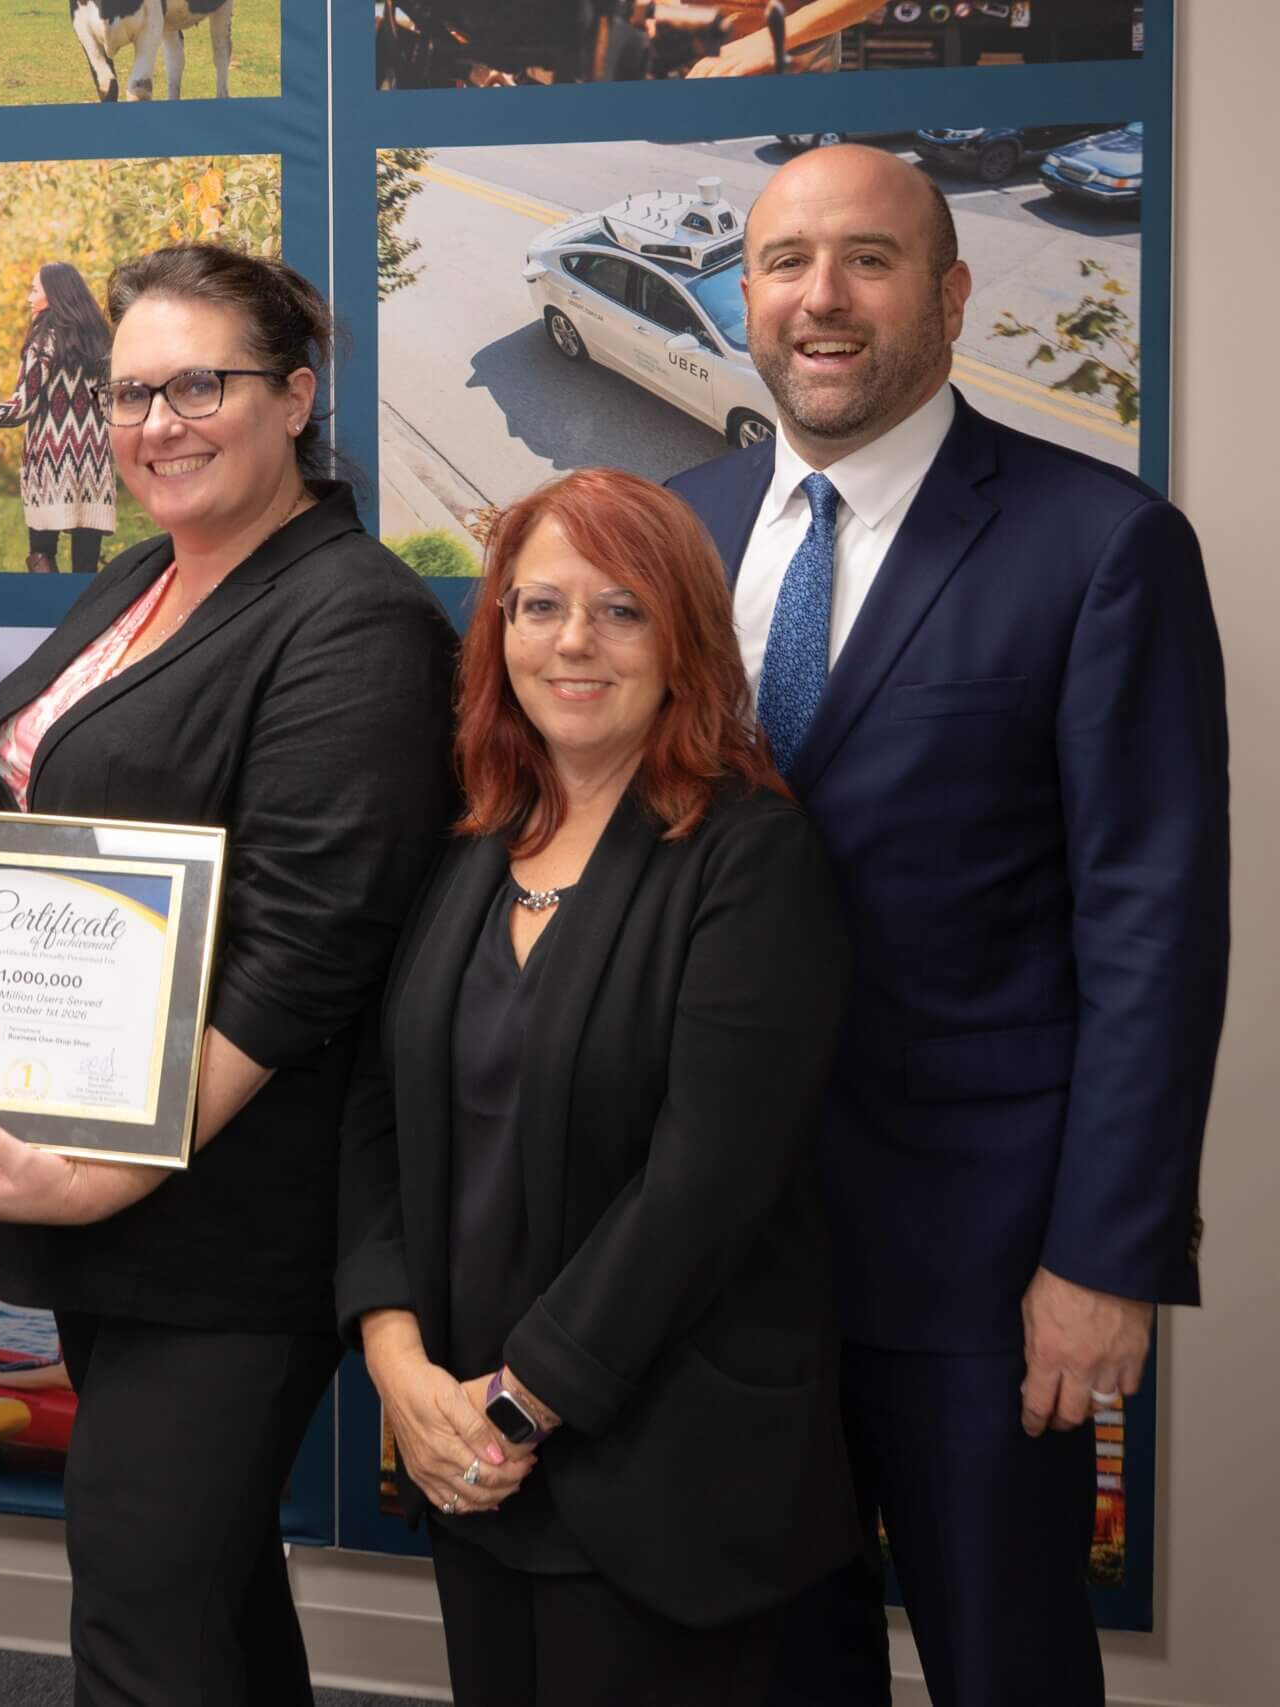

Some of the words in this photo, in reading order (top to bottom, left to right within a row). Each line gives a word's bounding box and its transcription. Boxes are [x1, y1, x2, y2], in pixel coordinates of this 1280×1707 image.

[668, 351, 709, 382] UBER
[0, 969, 83, 989] 1,000,000
[0, 988, 33, 1002] Million
[36, 993, 64, 1005] Users
[66, 995, 103, 1009] Served
[1, 1002, 43, 1016] October
[46, 1008, 59, 1018] 1st
[61, 1010, 87, 1020] 2026
[23, 1063, 33, 1089] 1
